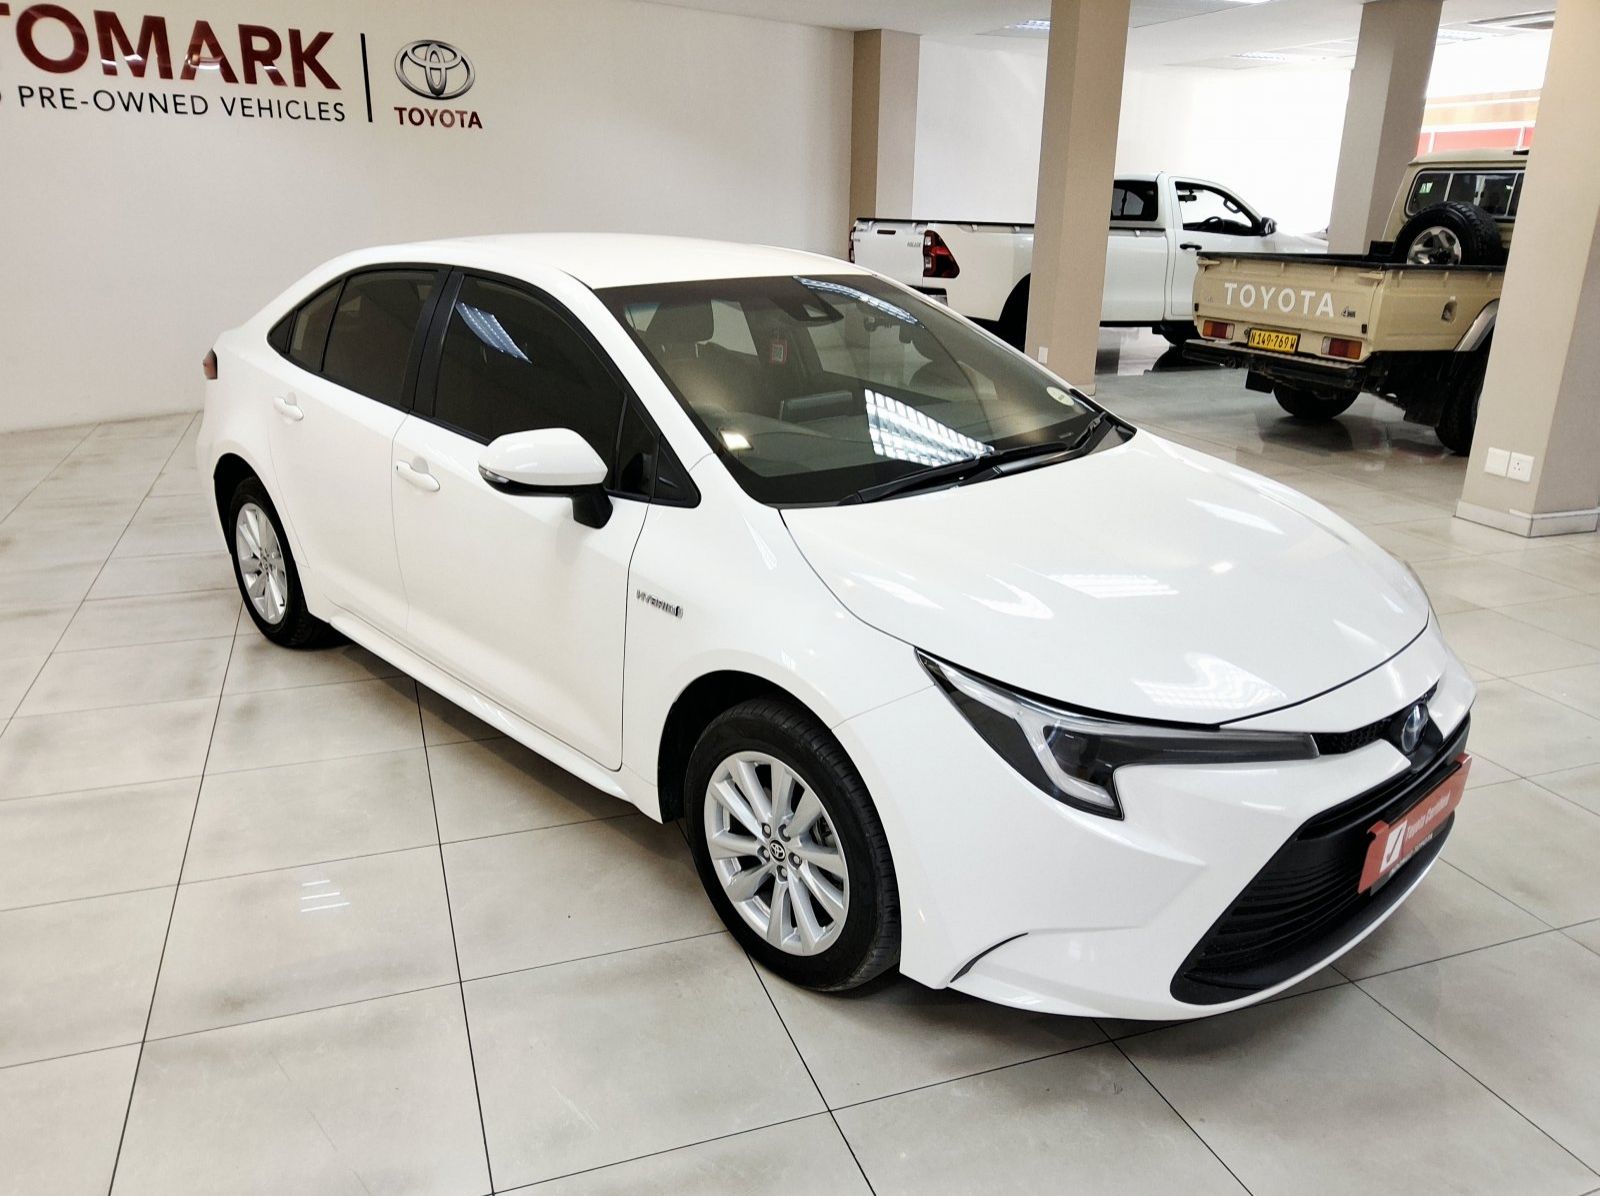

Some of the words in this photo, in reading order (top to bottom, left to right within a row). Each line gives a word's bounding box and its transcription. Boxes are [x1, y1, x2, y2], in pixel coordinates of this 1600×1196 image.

[0, 2, 342, 91] OMARK
[18, 85, 209, 117] PRE-OWNED
[219, 96, 346, 123] VEHICLES
[393, 106, 483, 130] TOYOTA
[1224, 282, 1335, 318] TOYOTA
